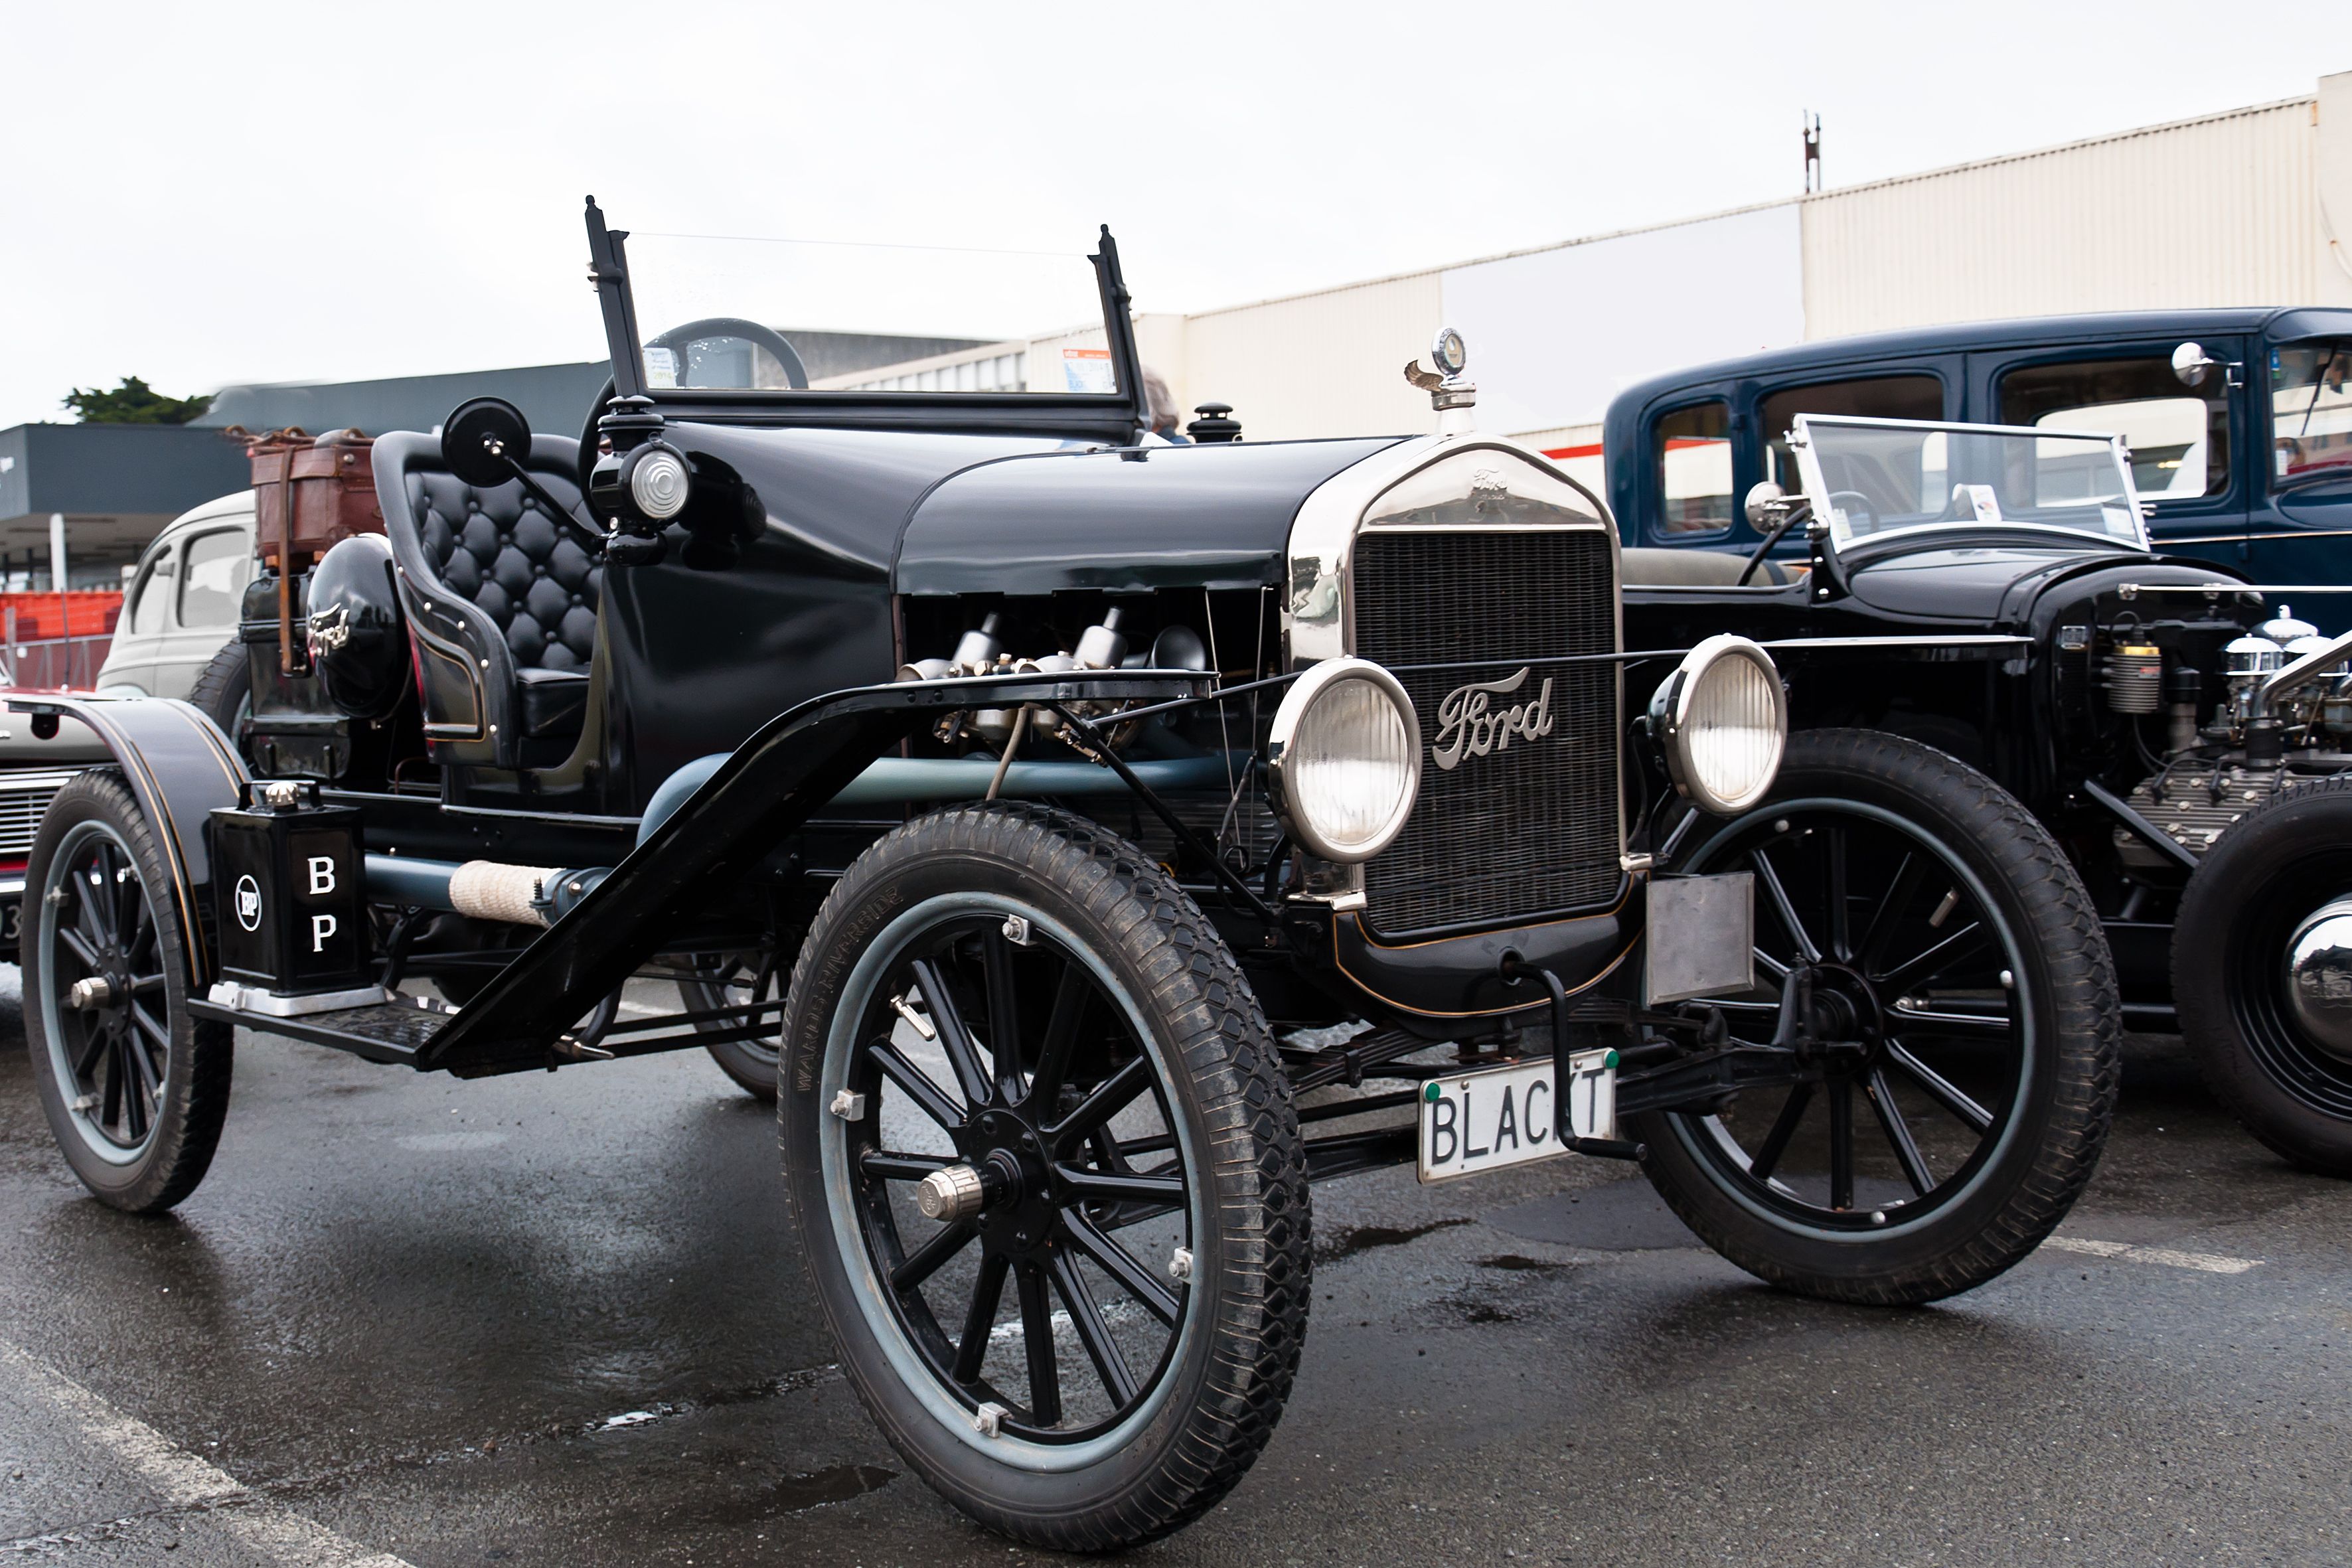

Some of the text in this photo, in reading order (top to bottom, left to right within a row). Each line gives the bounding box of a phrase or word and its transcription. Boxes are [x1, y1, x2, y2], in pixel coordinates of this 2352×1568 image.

[1473, 469, 1508, 491] Ford
[1433, 666, 1553, 770] Ford
[240, 891, 258, 916] BP
[797, 887, 903, 1092] WARDS RIVERSIDE
